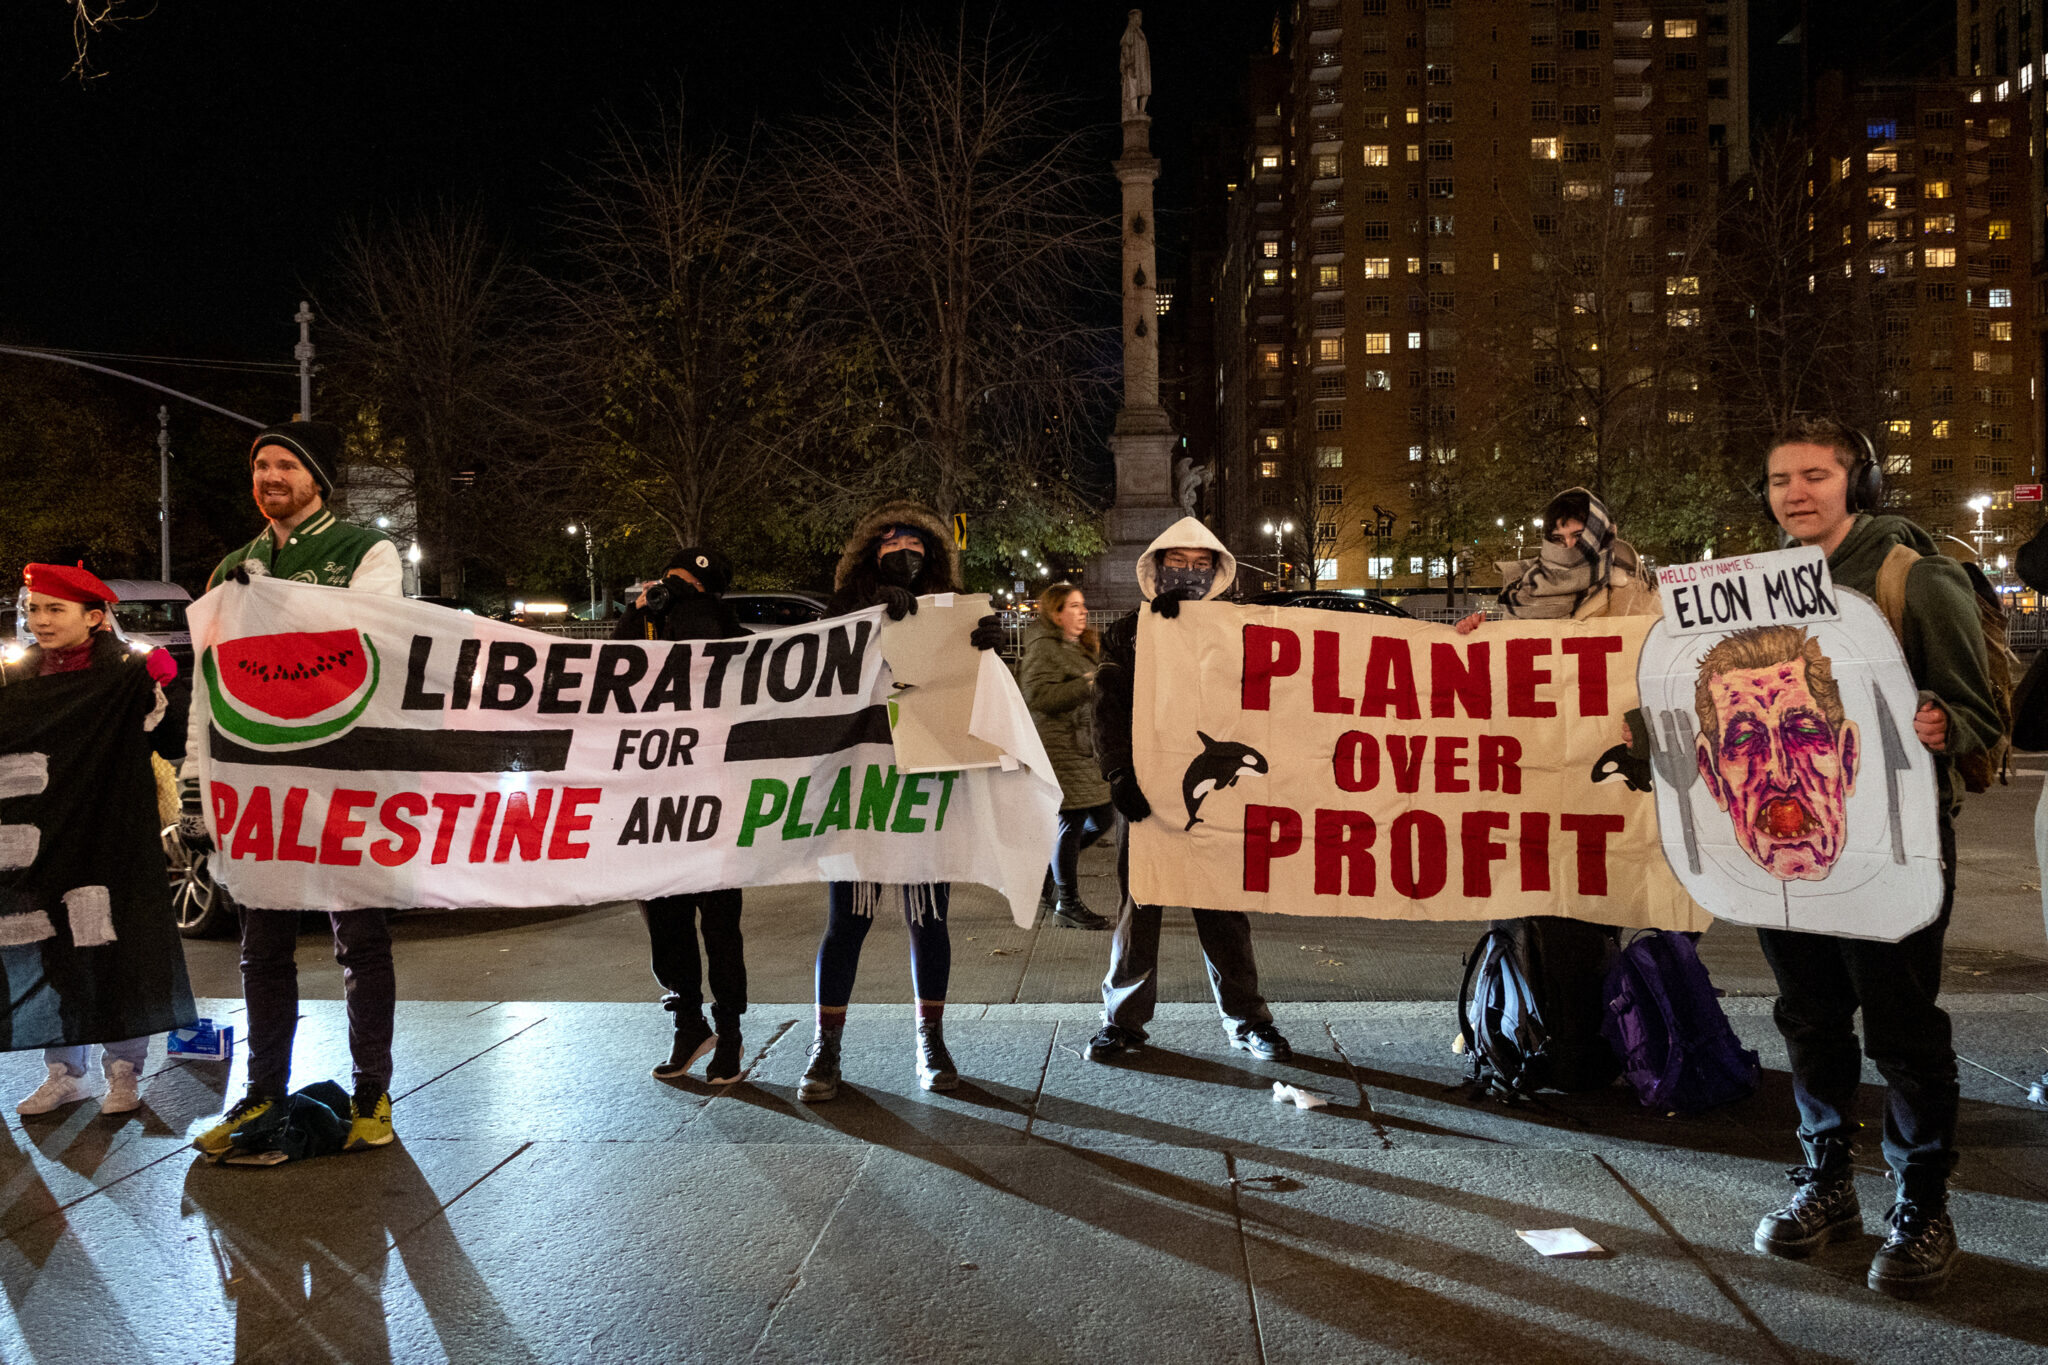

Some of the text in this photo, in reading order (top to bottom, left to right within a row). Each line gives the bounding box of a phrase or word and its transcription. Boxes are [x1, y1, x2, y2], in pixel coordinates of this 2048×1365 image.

[1659, 567, 1697, 584] HELLO
[1700, 564, 1714, 579] MY
[1715, 559, 1740, 575] NAME
[1673, 559, 1837, 629] ELON MUSK
[401, 620, 873, 714] LIBERATION
[1241, 623, 1623, 720] PLANET
[612, 727, 700, 772] FOR
[1332, 729, 1523, 795] OVER
[210, 780, 603, 867] PALESTINE
[617, 795, 722, 846] AND
[736, 763, 960, 848] PLANET
[1243, 803, 1625, 900] PROFIT
